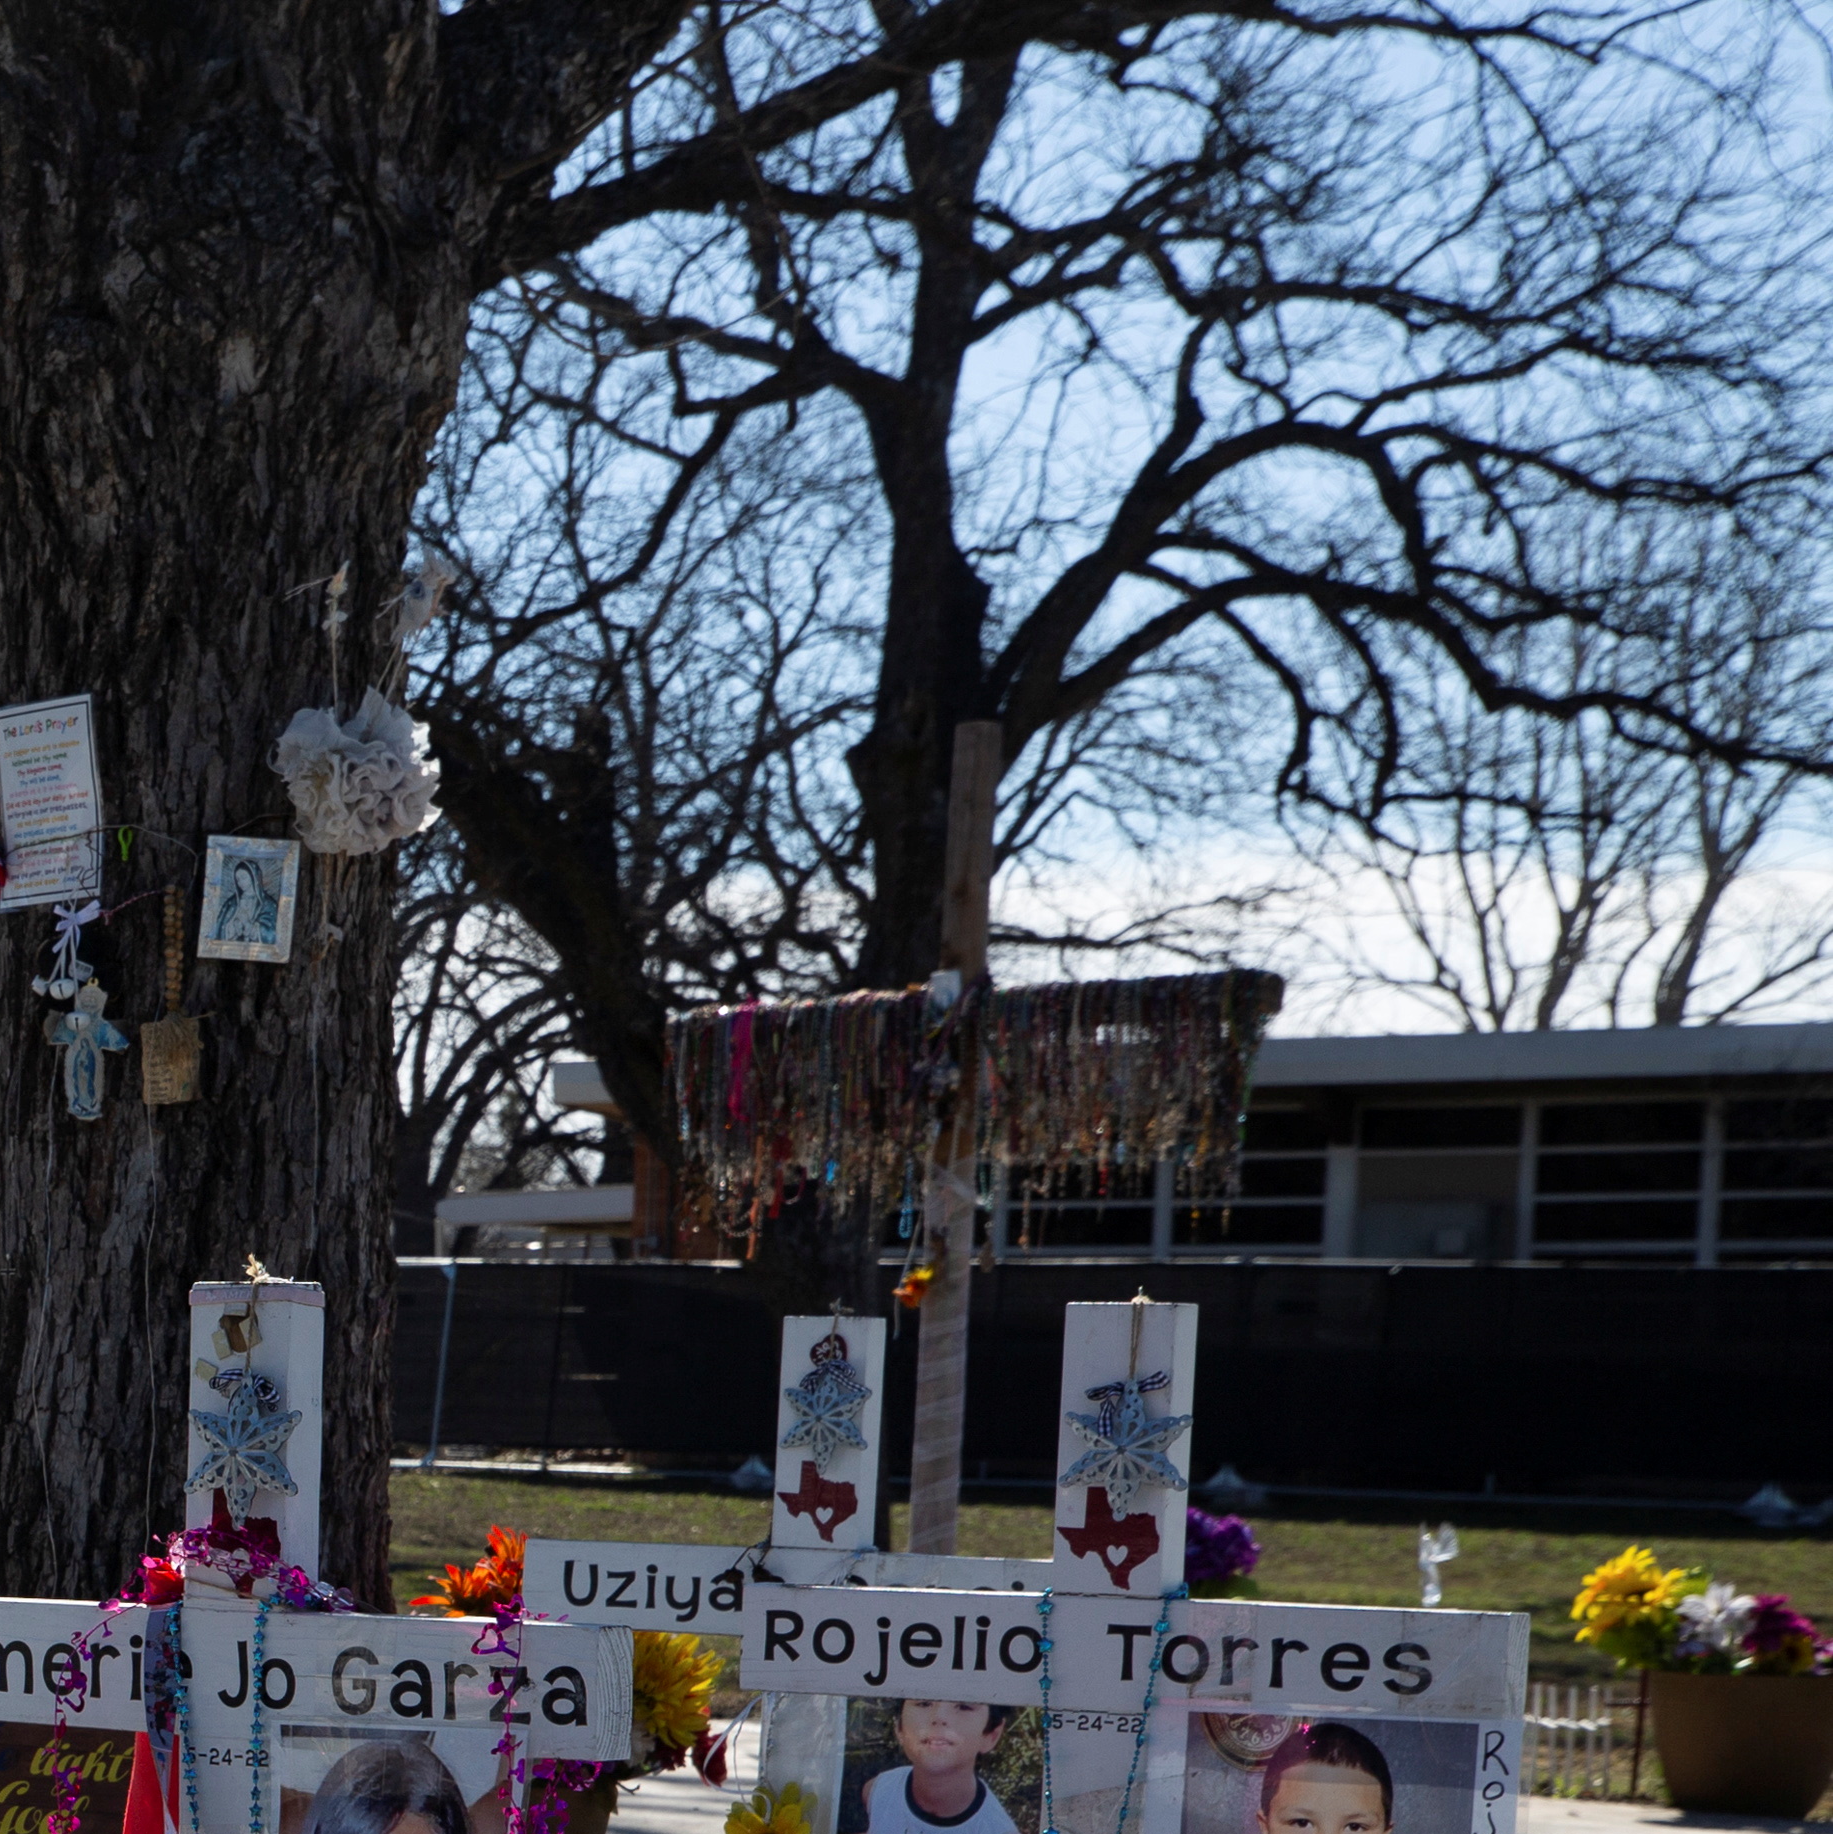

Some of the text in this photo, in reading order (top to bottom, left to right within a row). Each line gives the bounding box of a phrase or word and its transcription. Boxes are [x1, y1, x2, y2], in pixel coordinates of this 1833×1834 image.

[45, 716, 78, 734] Prayer
[563, 1559, 745, 1623] Uziya
[216, 1639, 296, 1710] Jo
[331, 1644, 589, 1728] Garza
[763, 1609, 1434, 1696] Rojelio Torres
[1052, 1714, 1144, 1734] 5-24-22
